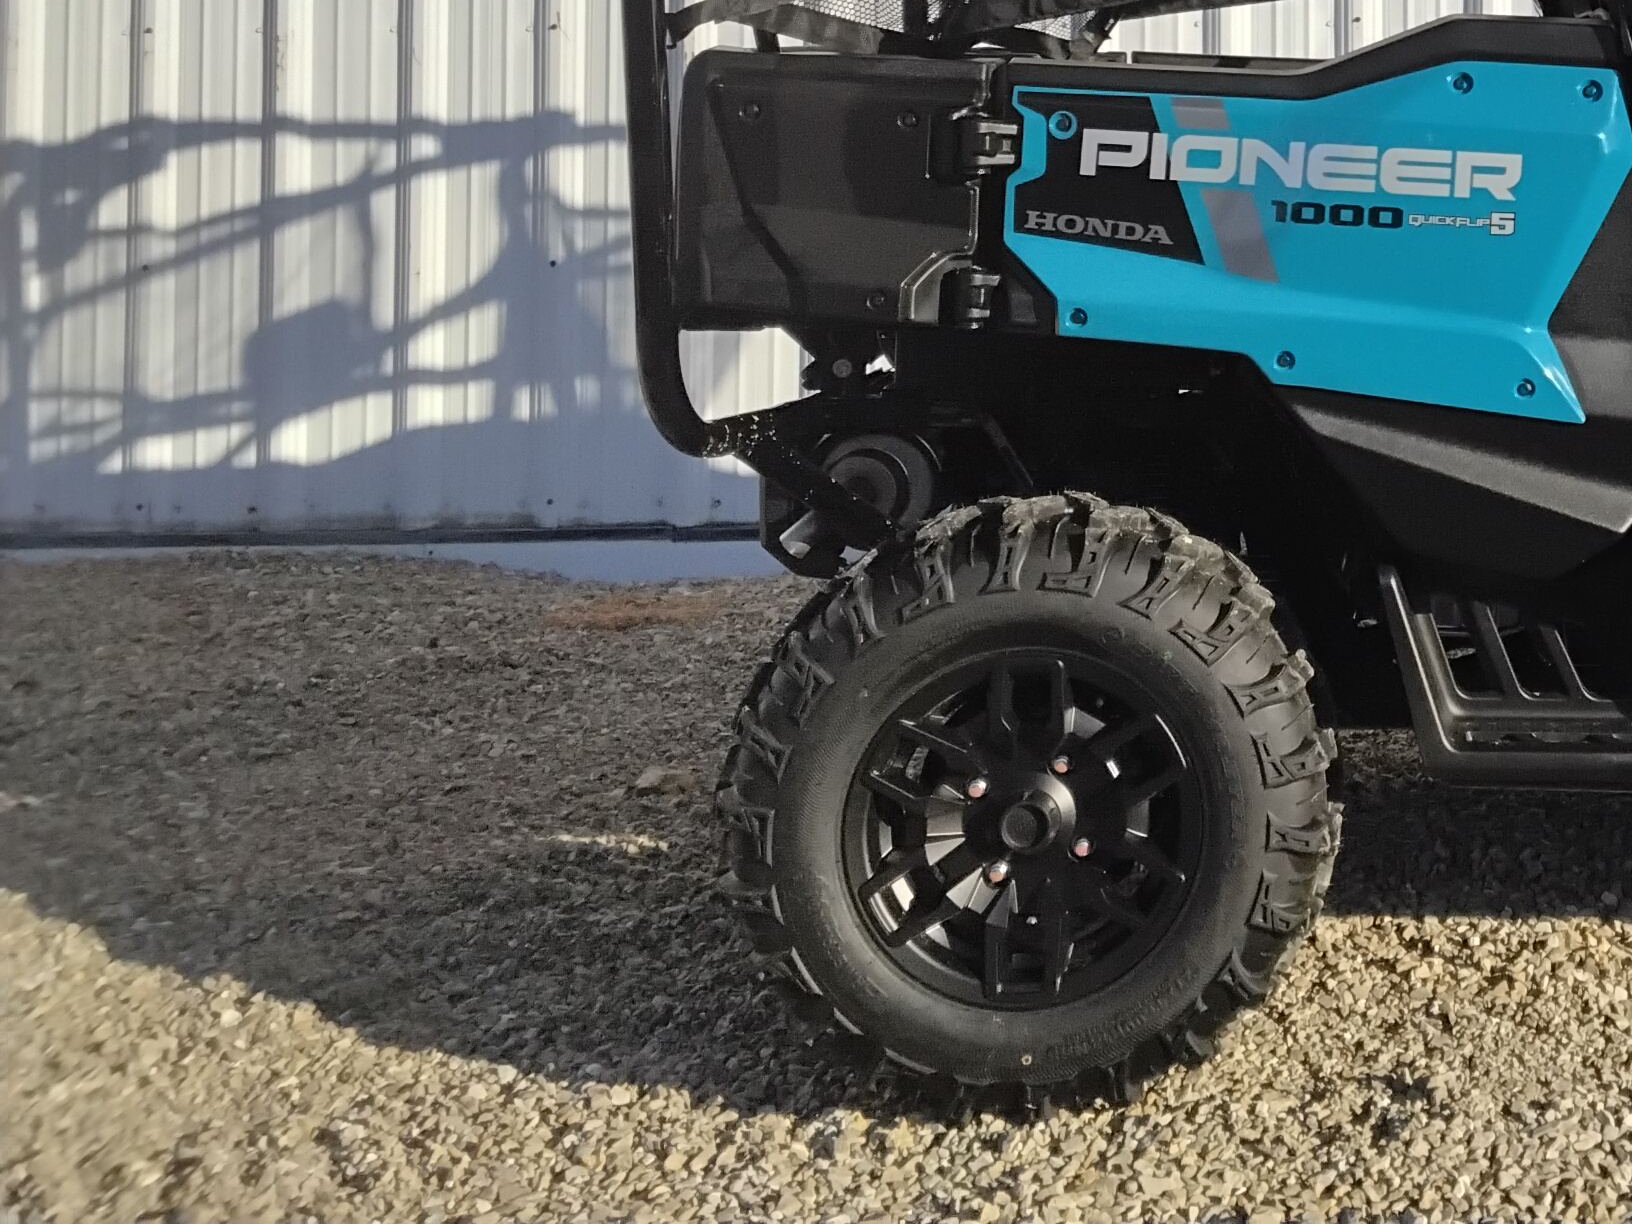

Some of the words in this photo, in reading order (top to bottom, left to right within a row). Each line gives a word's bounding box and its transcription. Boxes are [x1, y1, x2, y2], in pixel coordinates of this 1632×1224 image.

[1078, 128, 1523, 202] PIONEER
[1023, 209, 1174, 246] HONDA
[1270, 199, 1404, 230] 1000
